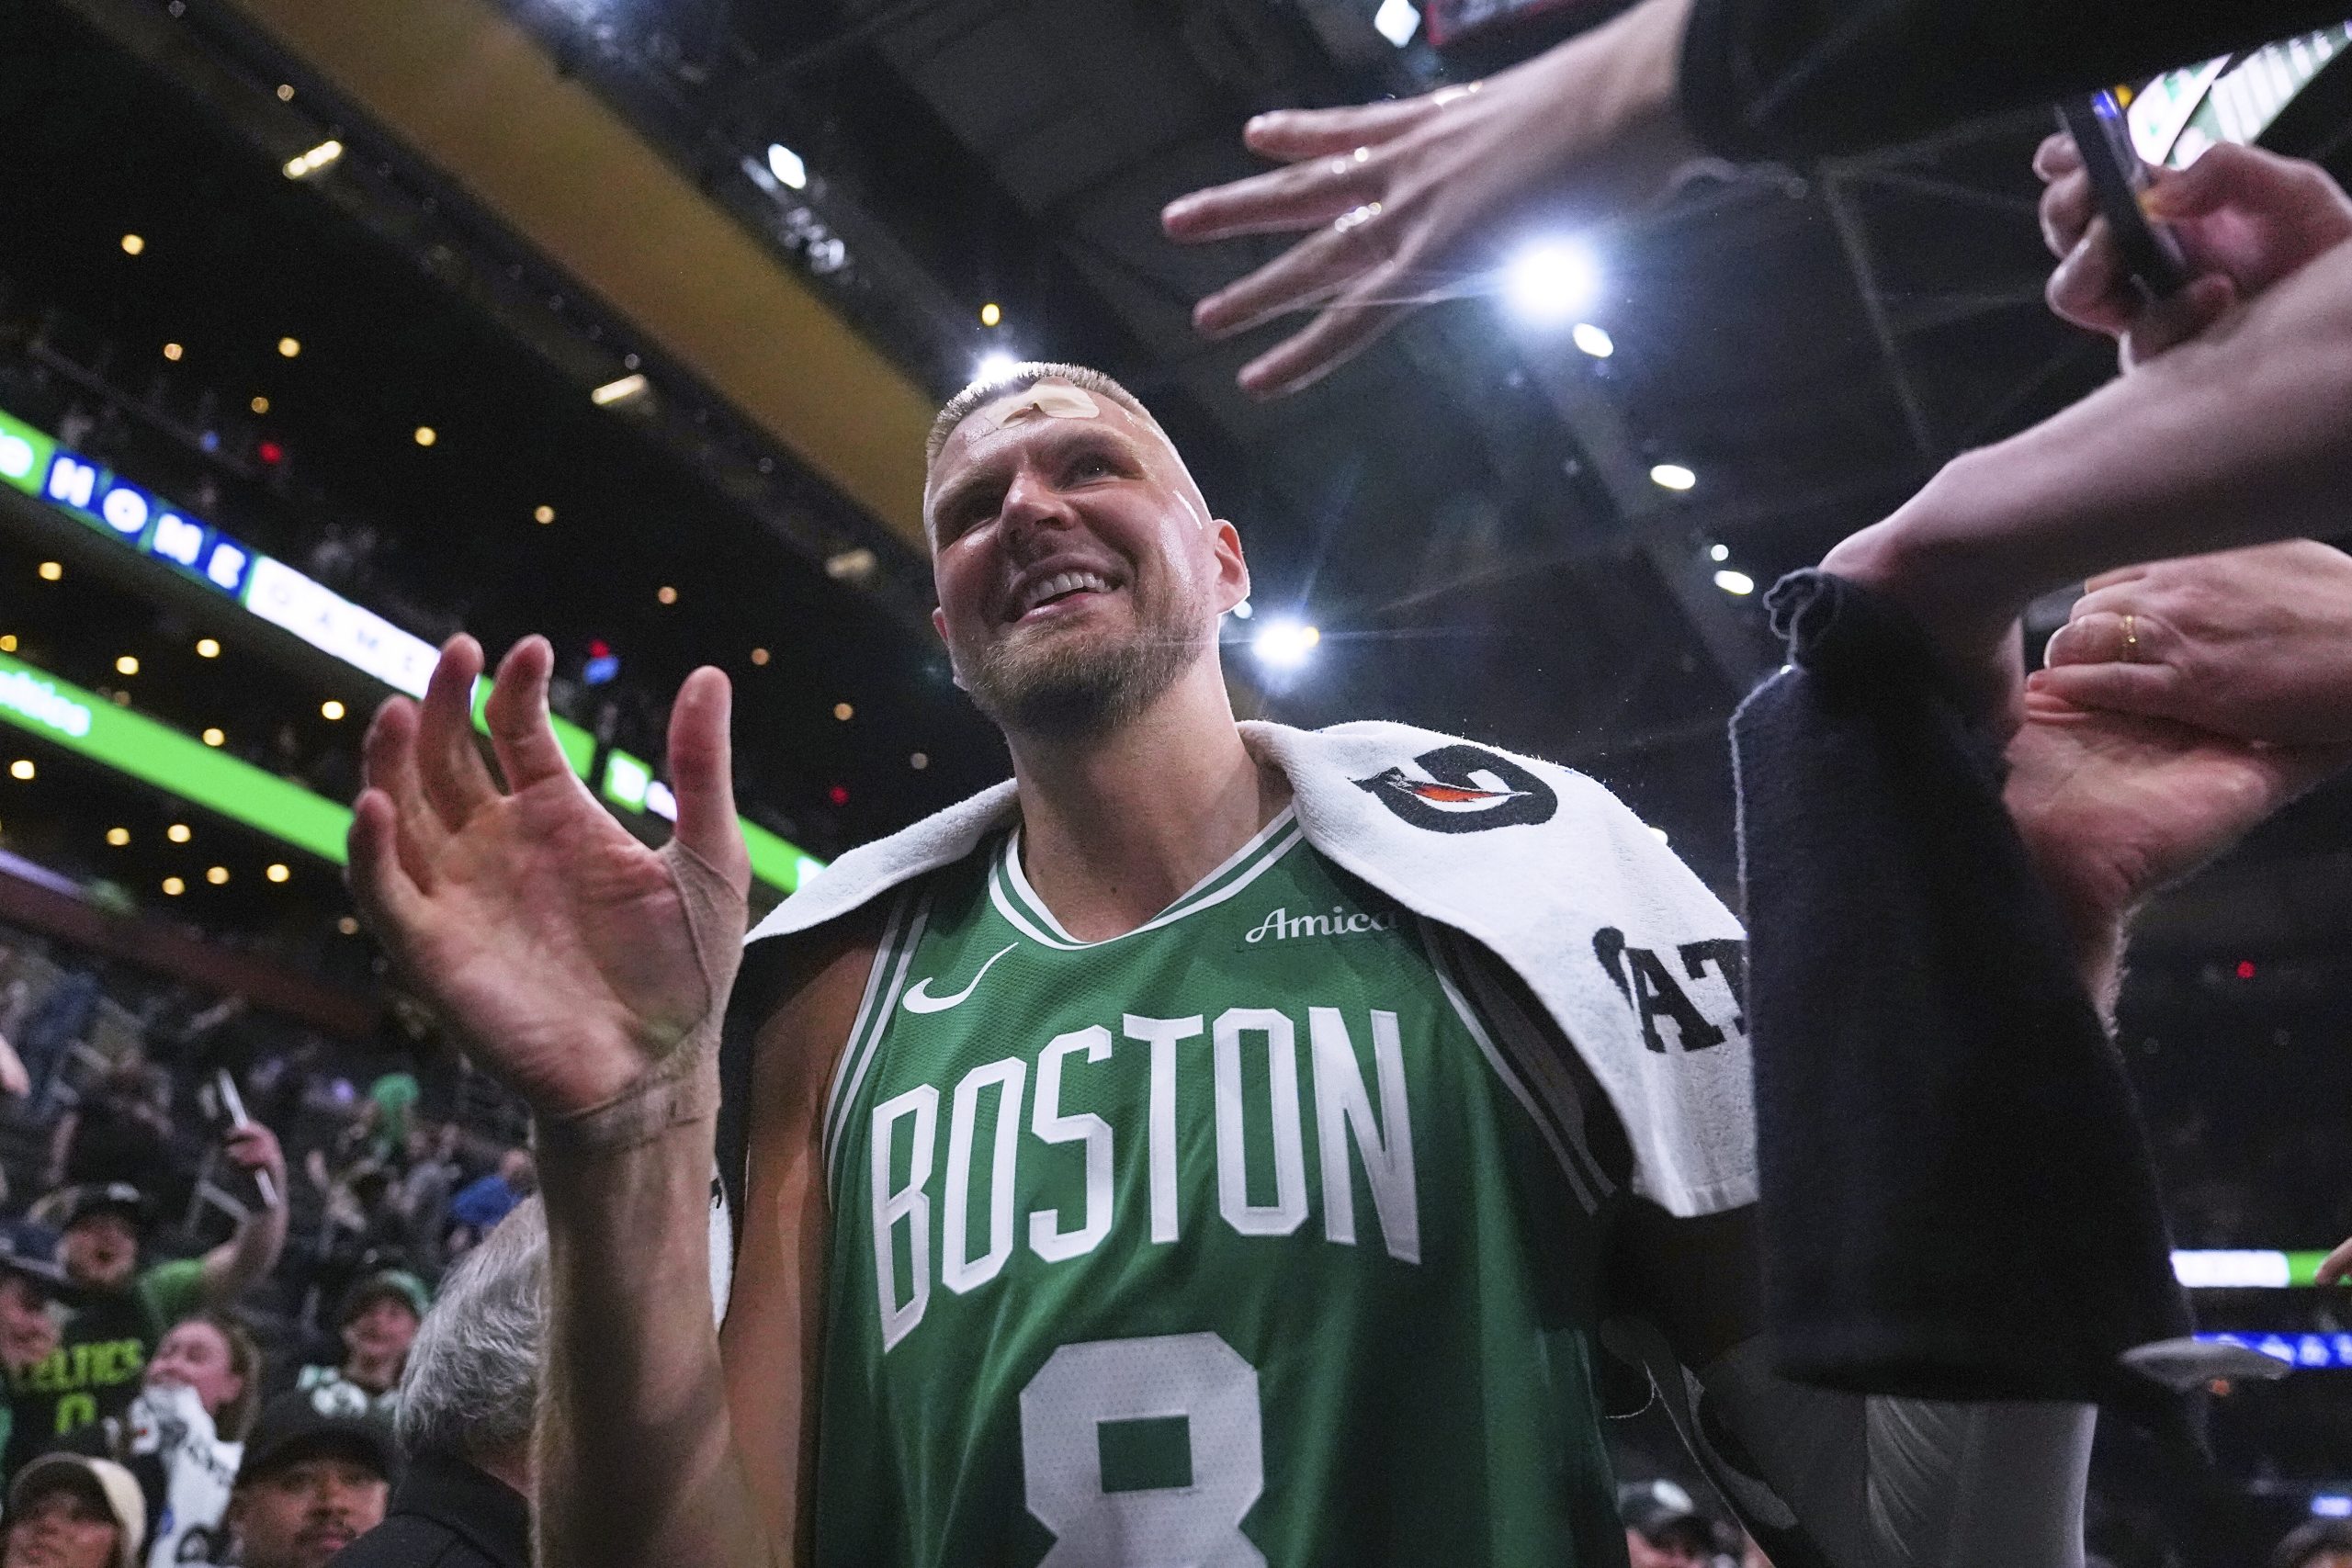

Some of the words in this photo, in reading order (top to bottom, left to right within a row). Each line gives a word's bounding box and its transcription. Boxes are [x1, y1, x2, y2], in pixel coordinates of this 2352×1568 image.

[48, 456, 247, 590] HOME
[871, 1006, 1422, 1355] BOSTON
[1019, 1330, 1269, 1568] 8
